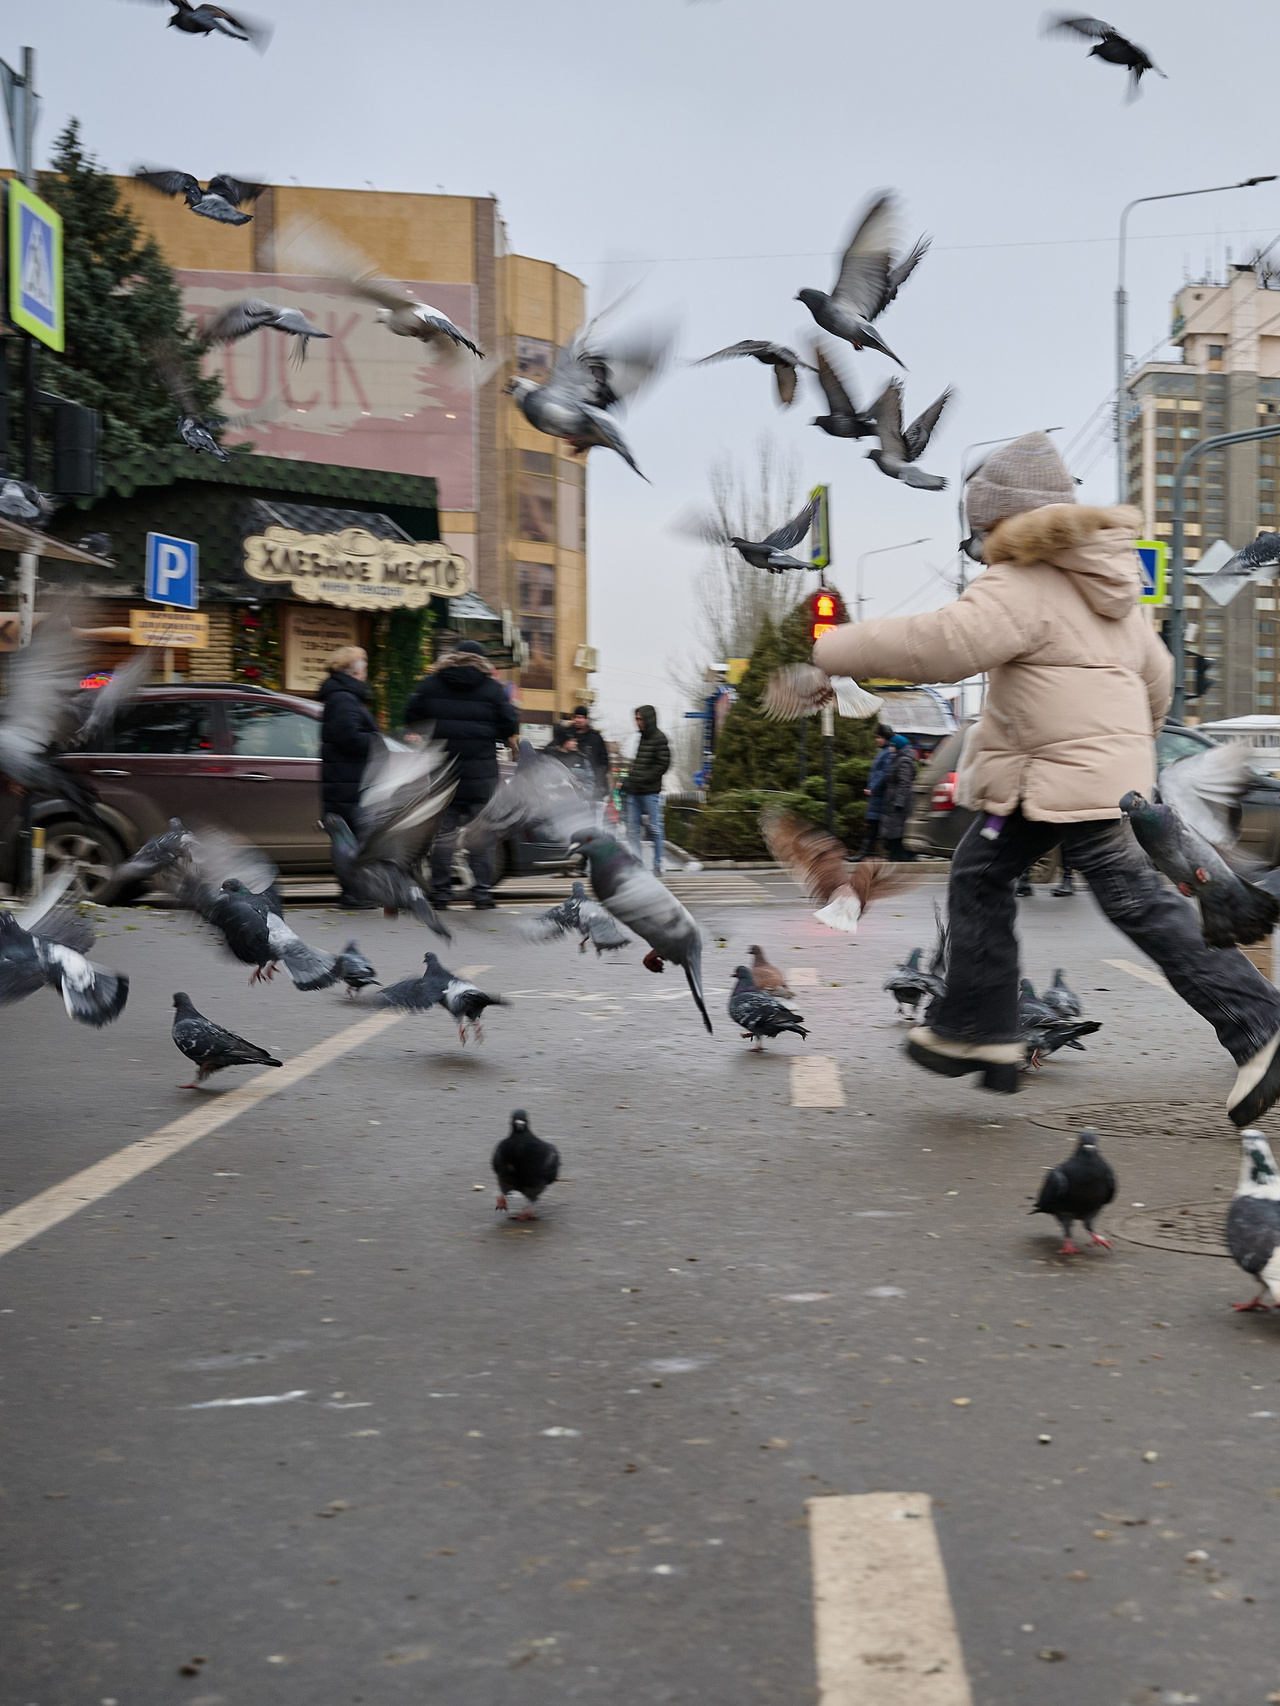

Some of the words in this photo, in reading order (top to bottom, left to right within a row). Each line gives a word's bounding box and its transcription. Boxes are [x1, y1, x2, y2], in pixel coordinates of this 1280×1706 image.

[156, 543, 188, 596] P
[262, 543, 373, 581] ХЛЕБНОЕ
[382, 559, 459, 588] МЕСТО
